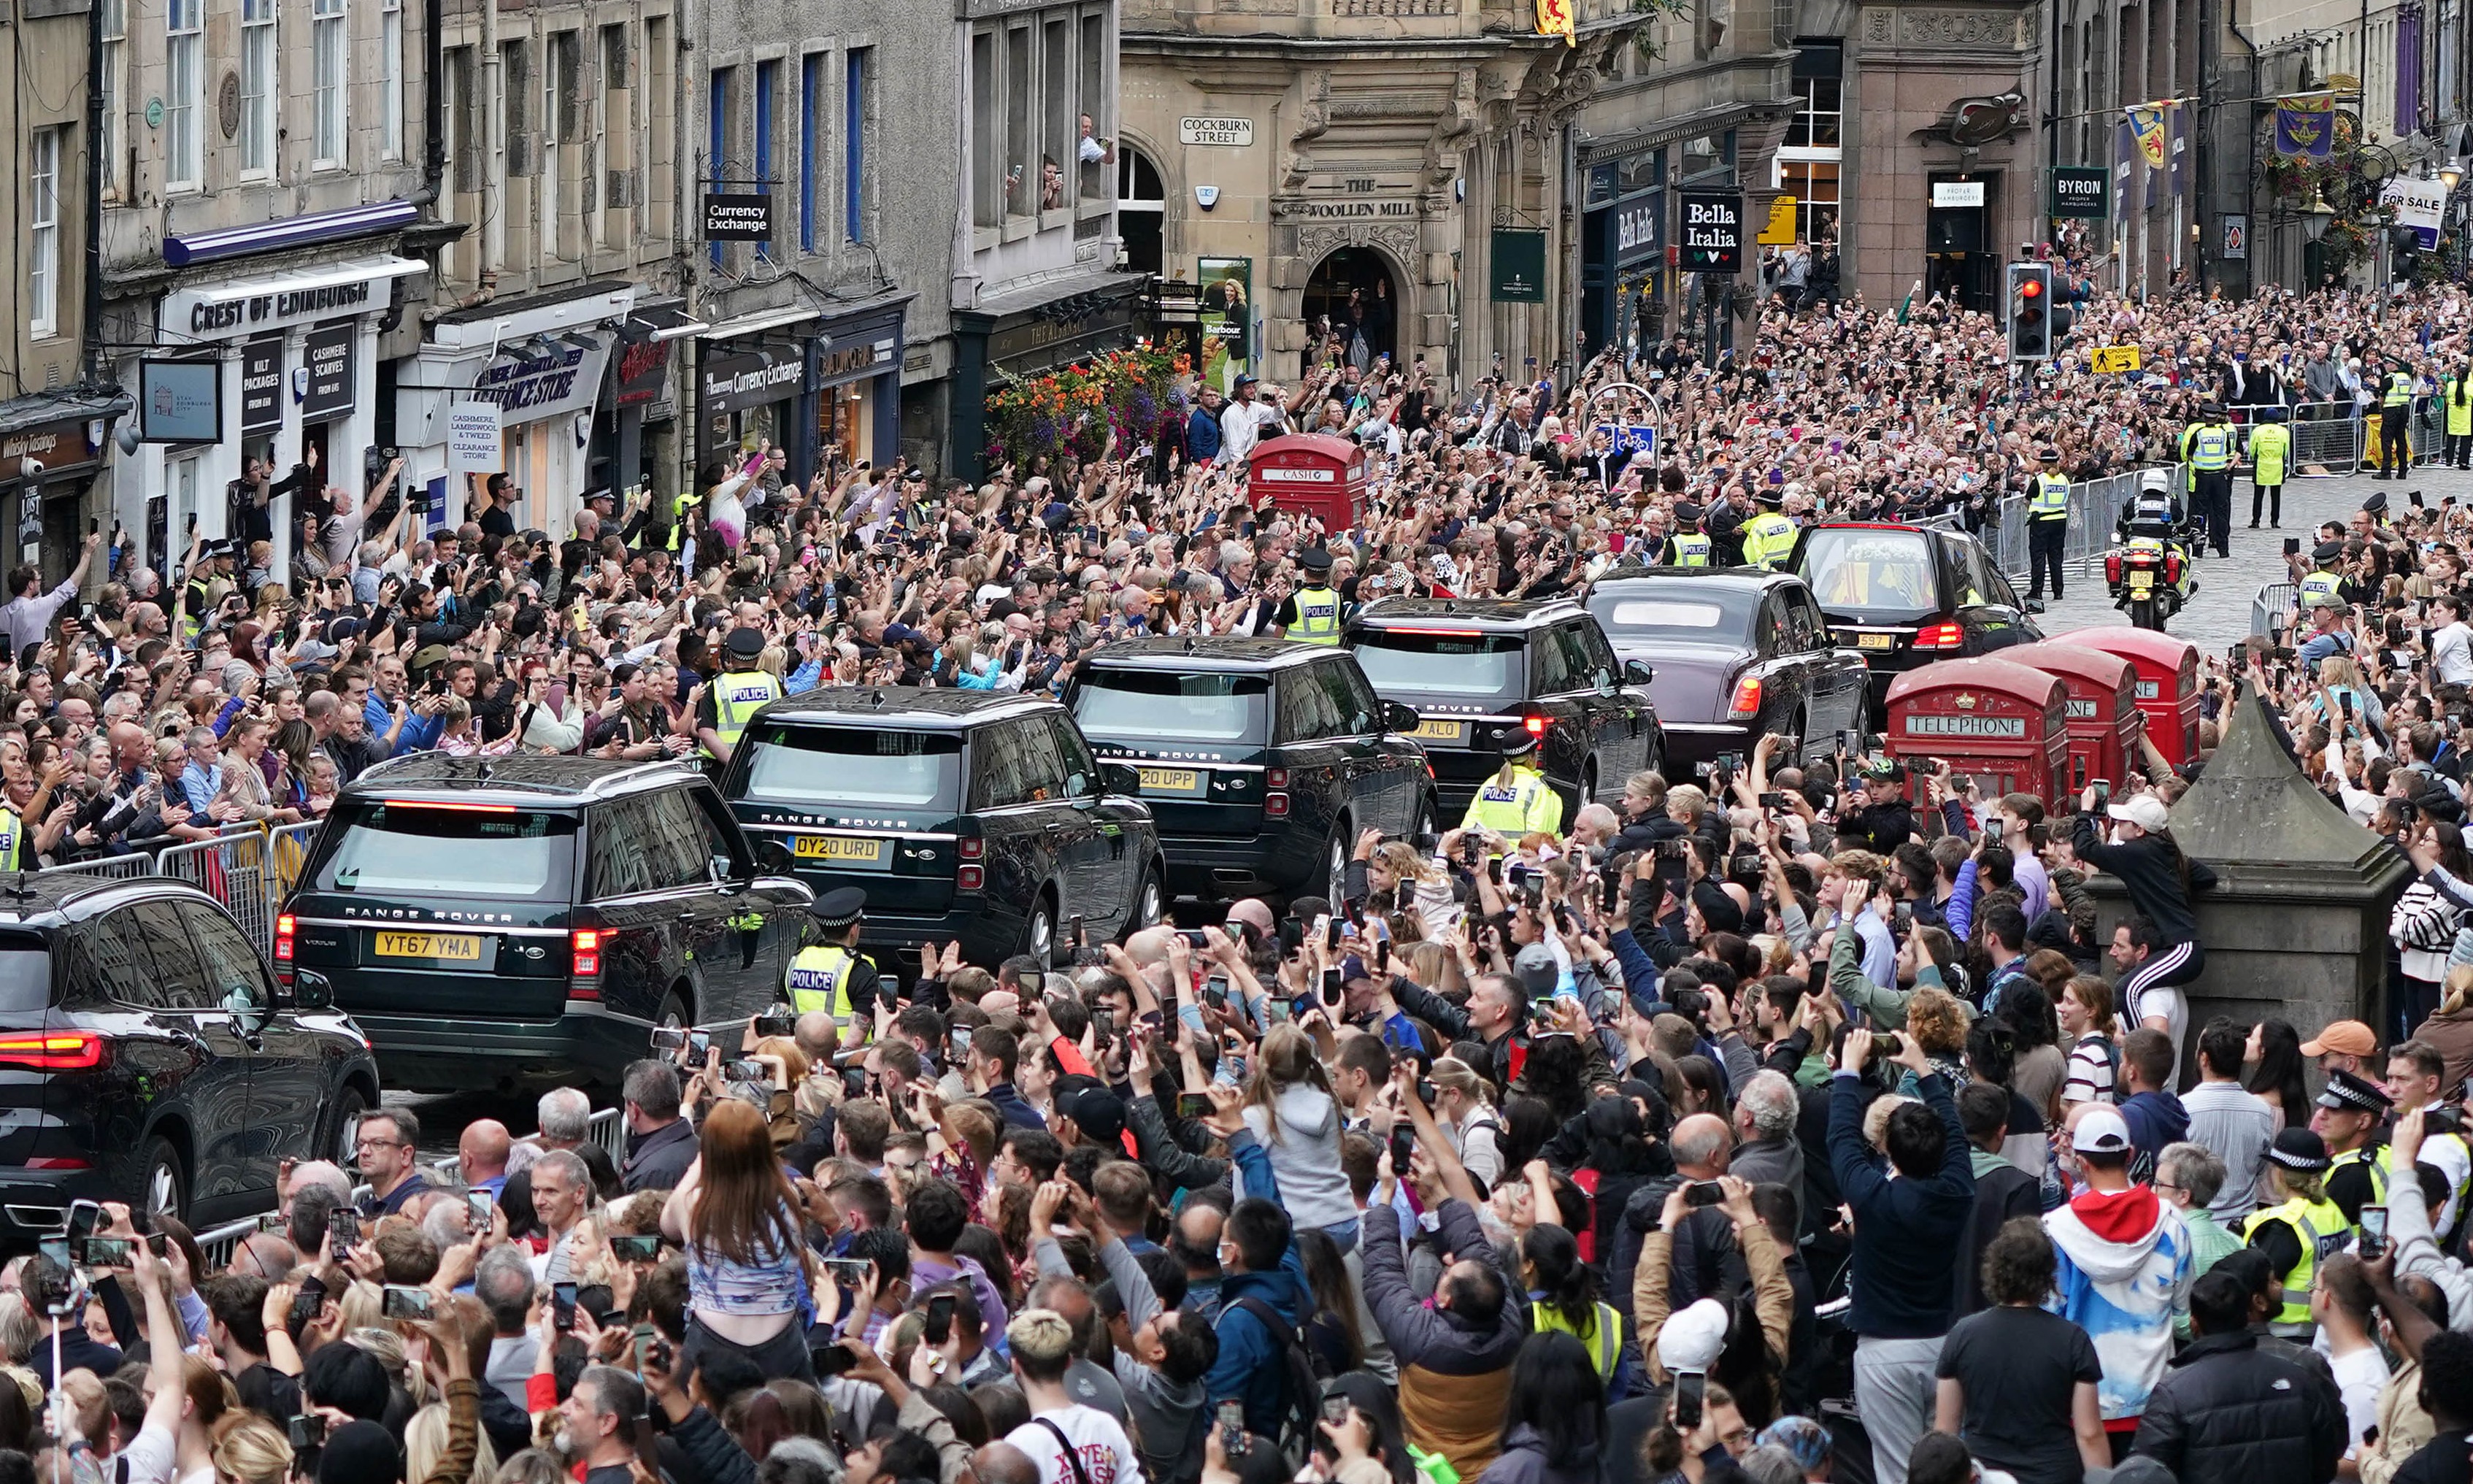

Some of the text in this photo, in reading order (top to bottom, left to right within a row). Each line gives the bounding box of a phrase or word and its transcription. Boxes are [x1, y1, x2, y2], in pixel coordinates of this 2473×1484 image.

[1183, 119, 1250, 131] COCKBURN
[1194, 131, 1237, 142] STREET
[1345, 180, 1375, 193] THE
[2058, 180, 2100, 194] BYRON
[2382, 195, 2440, 211] FOR SALE
[709, 204, 766, 219] Currency
[1309, 203, 1414, 218] WOOLLEN MILL
[1688, 204, 1736, 224] Bella
[707, 218, 767, 232] Exchange
[1618, 207, 1653, 251] Bella Italia
[1687, 228, 1737, 247] Italia
[1159, 285, 1196, 295] BELHAVEN
[191, 281, 369, 332] CREST OF EDINBURGH
[1031, 326, 1046, 345] THE
[1206, 324, 1241, 334] Barbour
[312, 343, 347, 361] CASHMERE
[254, 358, 269, 374] KILT
[818, 345, 875, 377] BALMORAL
[315, 360, 344, 377] SCARVES
[244, 373, 279, 392] PACKAGES
[734, 372, 766, 393] Currency
[767, 361, 802, 384] Exchange
[534, 369, 578, 406] STORE
[453, 415, 496, 423] CASHMERE,
[451, 423, 498, 431] LAMBSWOOL
[4, 432, 57, 460] Whisky Tastings
[453, 444, 497, 452] CLEARANCE
[1283, 471, 1312, 480] CASH
[24, 485, 38, 497] THE
[21, 496, 42, 521] LOST
[2139, 501, 2164, 510] POLICE
[1767, 525, 1788, 536] POLICE
[1685, 545, 1707, 555] POLICE
[2304, 583, 2327, 592] POLICE
[1306, 607, 1334, 617] POLICE
[1861, 637, 1882, 647] 597
[732, 688, 767, 701] POLICE
[1426, 704, 1483, 713] ROVER
[1428, 723, 1454, 735] ALO
[1911, 718, 2020, 734] TELEPHONE
[1160, 751, 1221, 761] ROVER
[1141, 771, 1192, 786] 20 UPP
[761, 814, 907, 828] RANGE ROVER
[797, 838, 875, 857] OY20 URD
[345, 907, 512, 923] RANGE ROVER
[385, 935, 472, 957] YT67 YMA
[791, 971, 832, 989] POLICE
